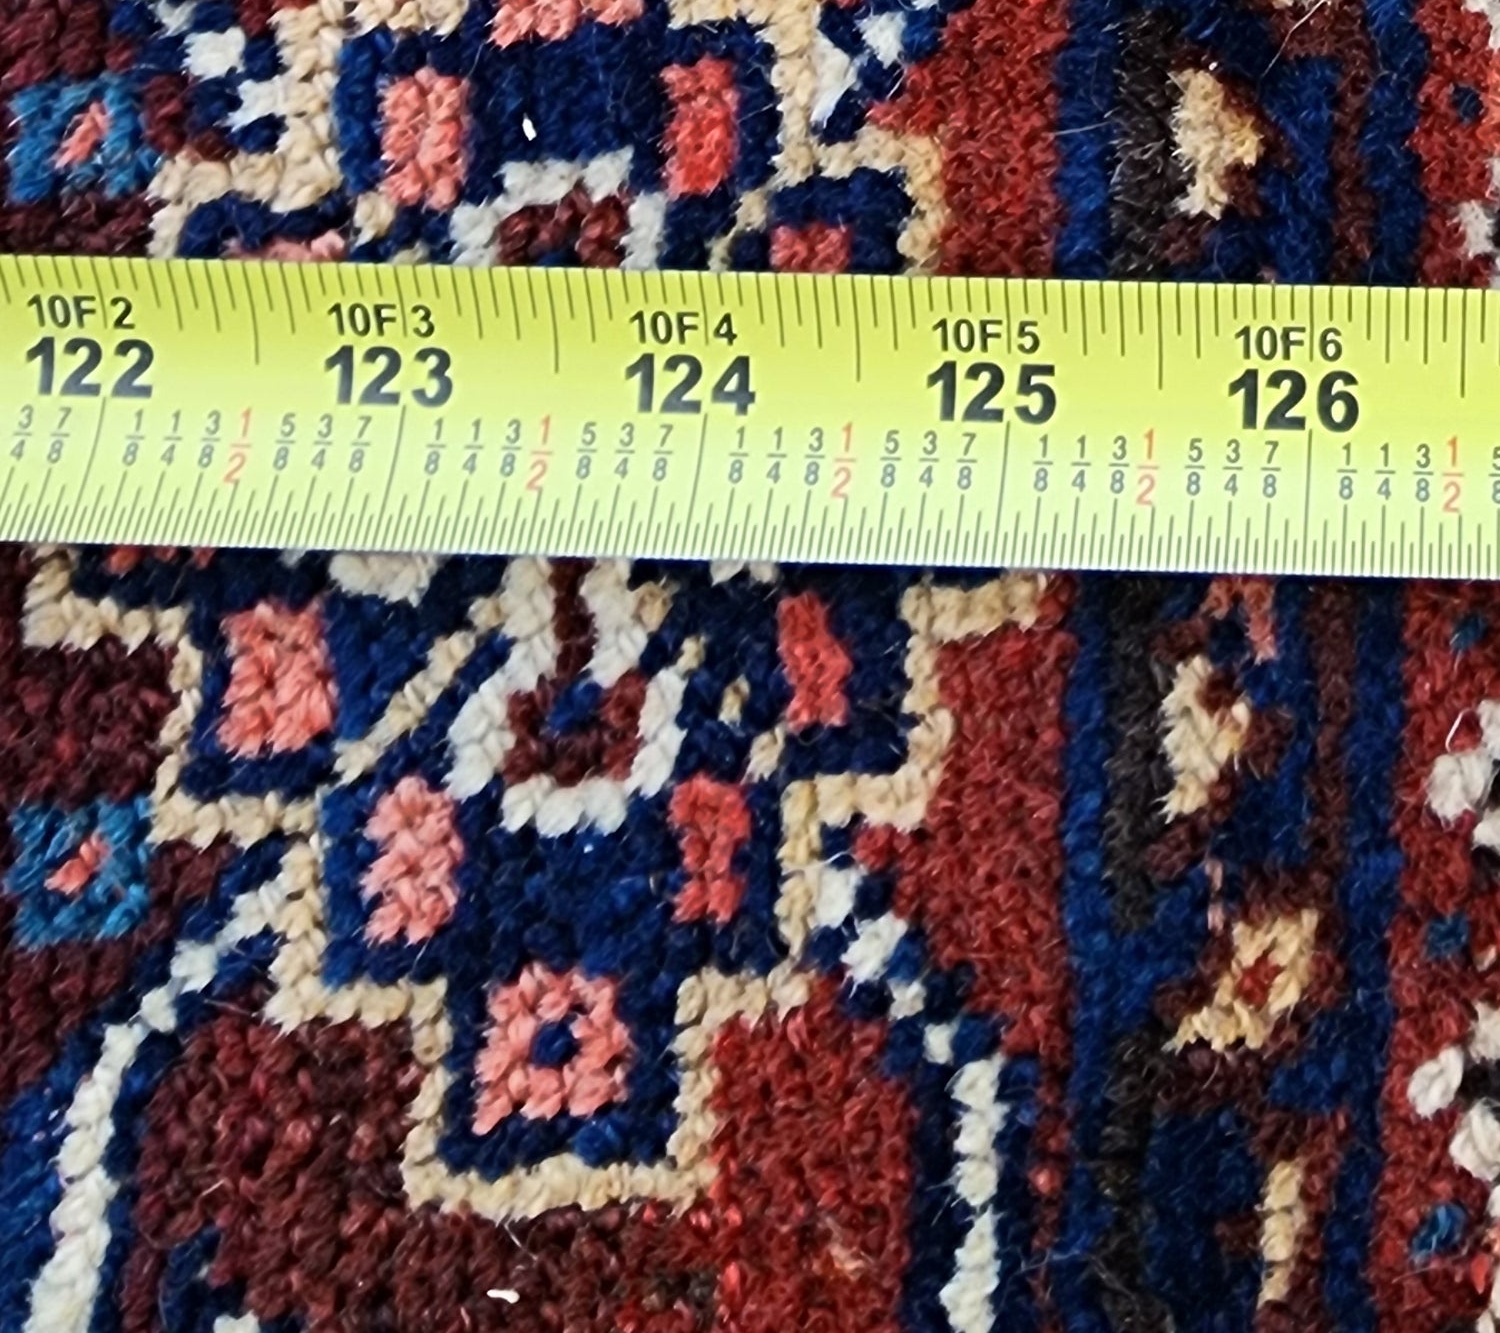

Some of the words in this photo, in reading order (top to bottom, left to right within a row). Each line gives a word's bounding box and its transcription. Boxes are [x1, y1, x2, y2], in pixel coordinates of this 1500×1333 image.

[26, 336, 154, 399] 122
[323, 344, 454, 408] 123
[624, 353, 756, 416] 124
[926, 360, 1056, 424] 125
[1227, 368, 1359, 431] 126
